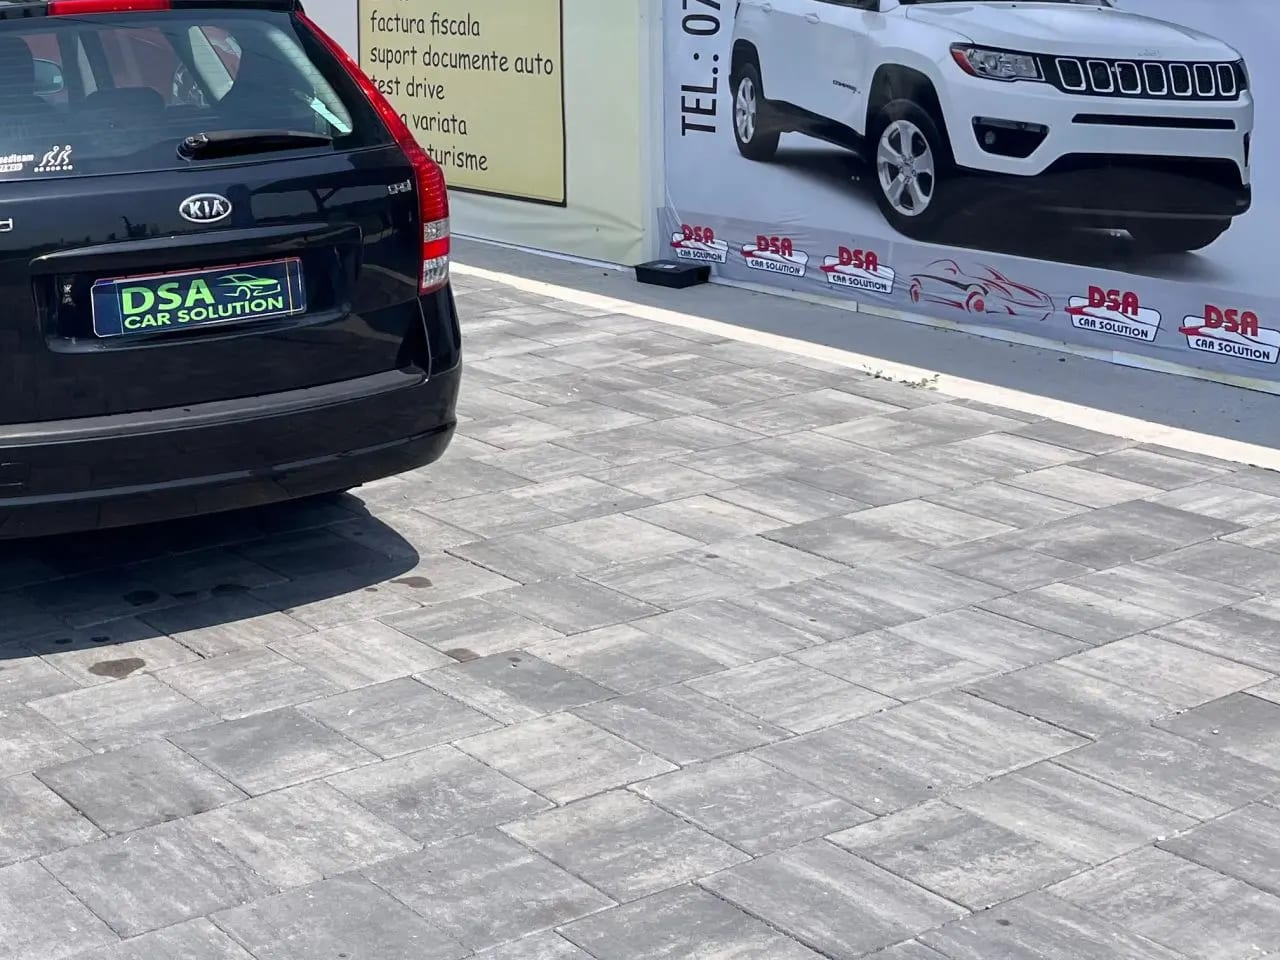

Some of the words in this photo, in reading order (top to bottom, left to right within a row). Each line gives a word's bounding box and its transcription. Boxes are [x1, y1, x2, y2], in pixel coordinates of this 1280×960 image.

[370, 9, 425, 34] factura
[430, 11, 481, 37] fiscala
[370, 45, 417, 70] suport
[422, 44, 509, 72] documente
[514, 53, 554, 75] auto
[371, 75, 401, 96] test
[406, 75, 445, 100] drive
[412, 111, 468, 136] variata
[422, 143, 489, 171] turisme
[187, 200, 226, 220] KIA
[681, 224, 715, 244] DSA
[756, 235, 793, 257] DSA
[680, 249, 691, 259] CAR
[692, 250, 722, 262] SOLUTION
[751, 259, 765, 269] CAR
[766, 261, 800, 274] SOLUTION
[838, 246, 878, 272] DSA
[832, 274, 847, 285] CAR
[848, 278, 887, 291] SOLUTION
[121, 279, 215, 315] DSA
[1088, 285, 1139, 316] DSA
[125, 312, 171, 329] CAR
[178, 296, 284, 323] SOLUTION
[1205, 304, 1258, 337] DSA
[1078, 317, 1097, 328] CAR
[1099, 321, 1148, 339] SOLUTION
[1195, 339, 1215, 351] CAR
[1218, 343, 1270, 361] SOLUTION
